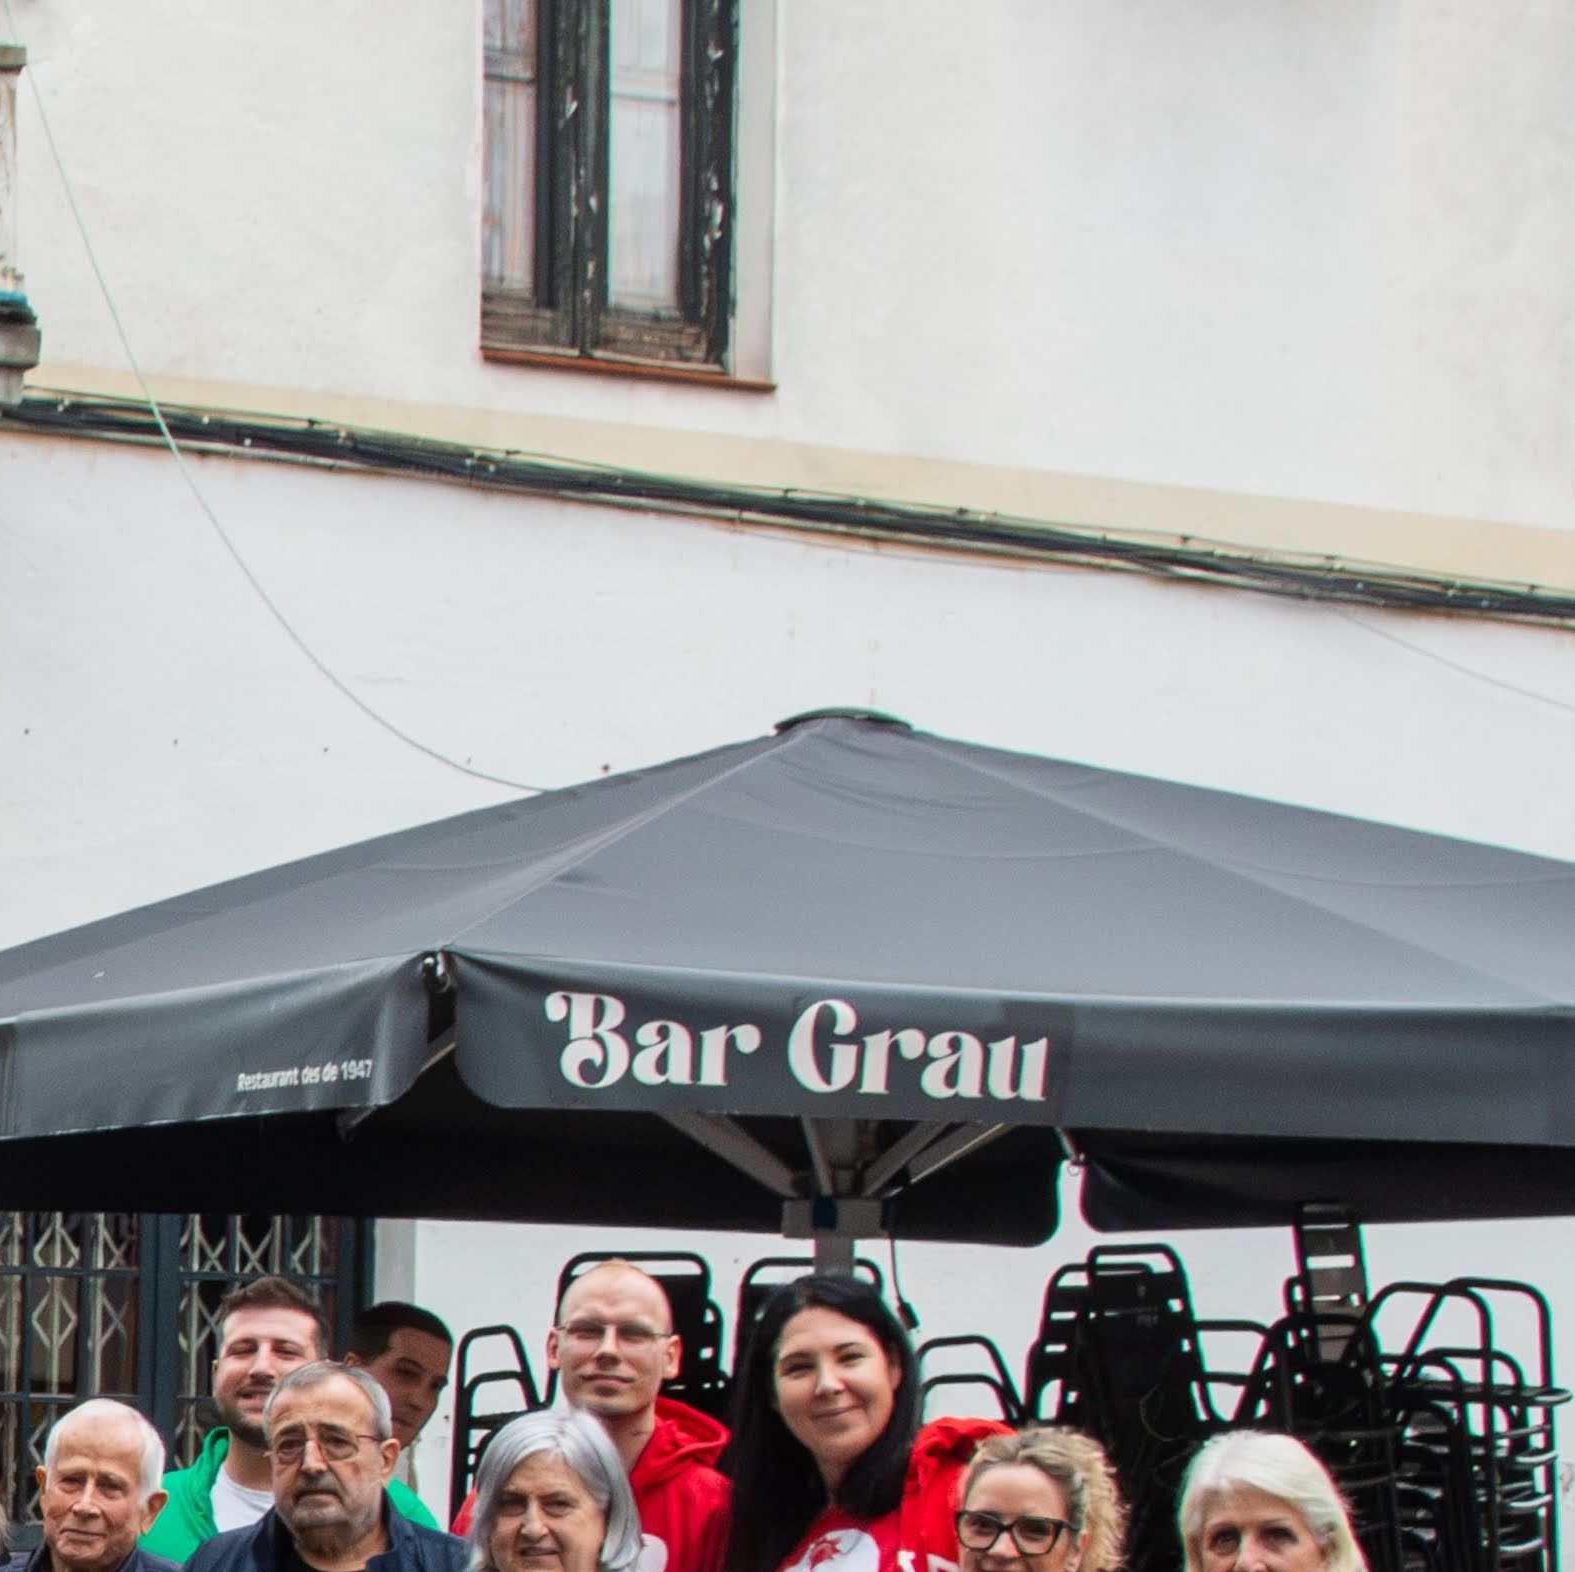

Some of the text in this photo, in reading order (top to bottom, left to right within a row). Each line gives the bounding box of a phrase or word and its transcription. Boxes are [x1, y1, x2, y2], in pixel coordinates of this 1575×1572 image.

[237, 1066, 300, 1092] Restaurant
[340, 1058, 374, 1081] 1947
[545, 991, 1048, 1101] Bar Grau
